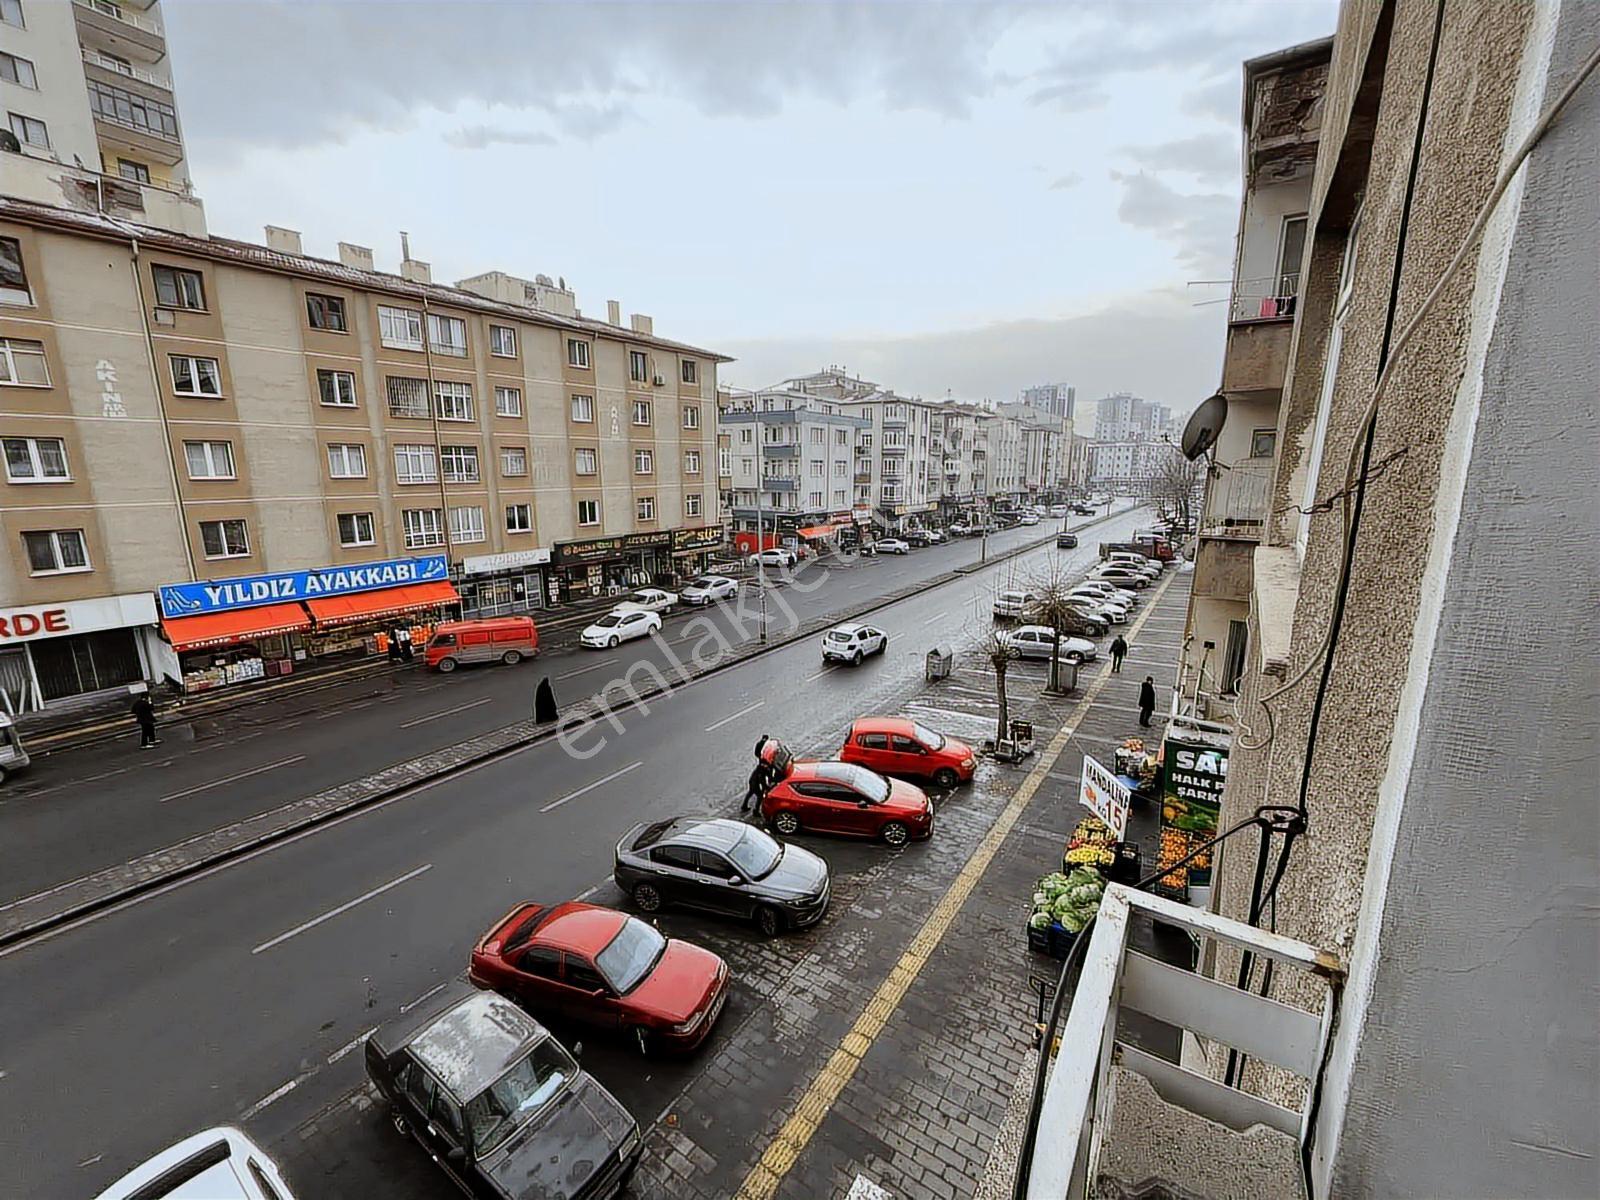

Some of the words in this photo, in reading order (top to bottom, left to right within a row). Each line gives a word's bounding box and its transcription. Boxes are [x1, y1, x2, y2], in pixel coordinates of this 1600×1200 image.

[204, 576, 296, 606] YILDIZ
[304, 562, 417, 595] AYAKKABI
[1172, 772, 1211, 789] HALK
[1106, 799, 1123, 832] 15
